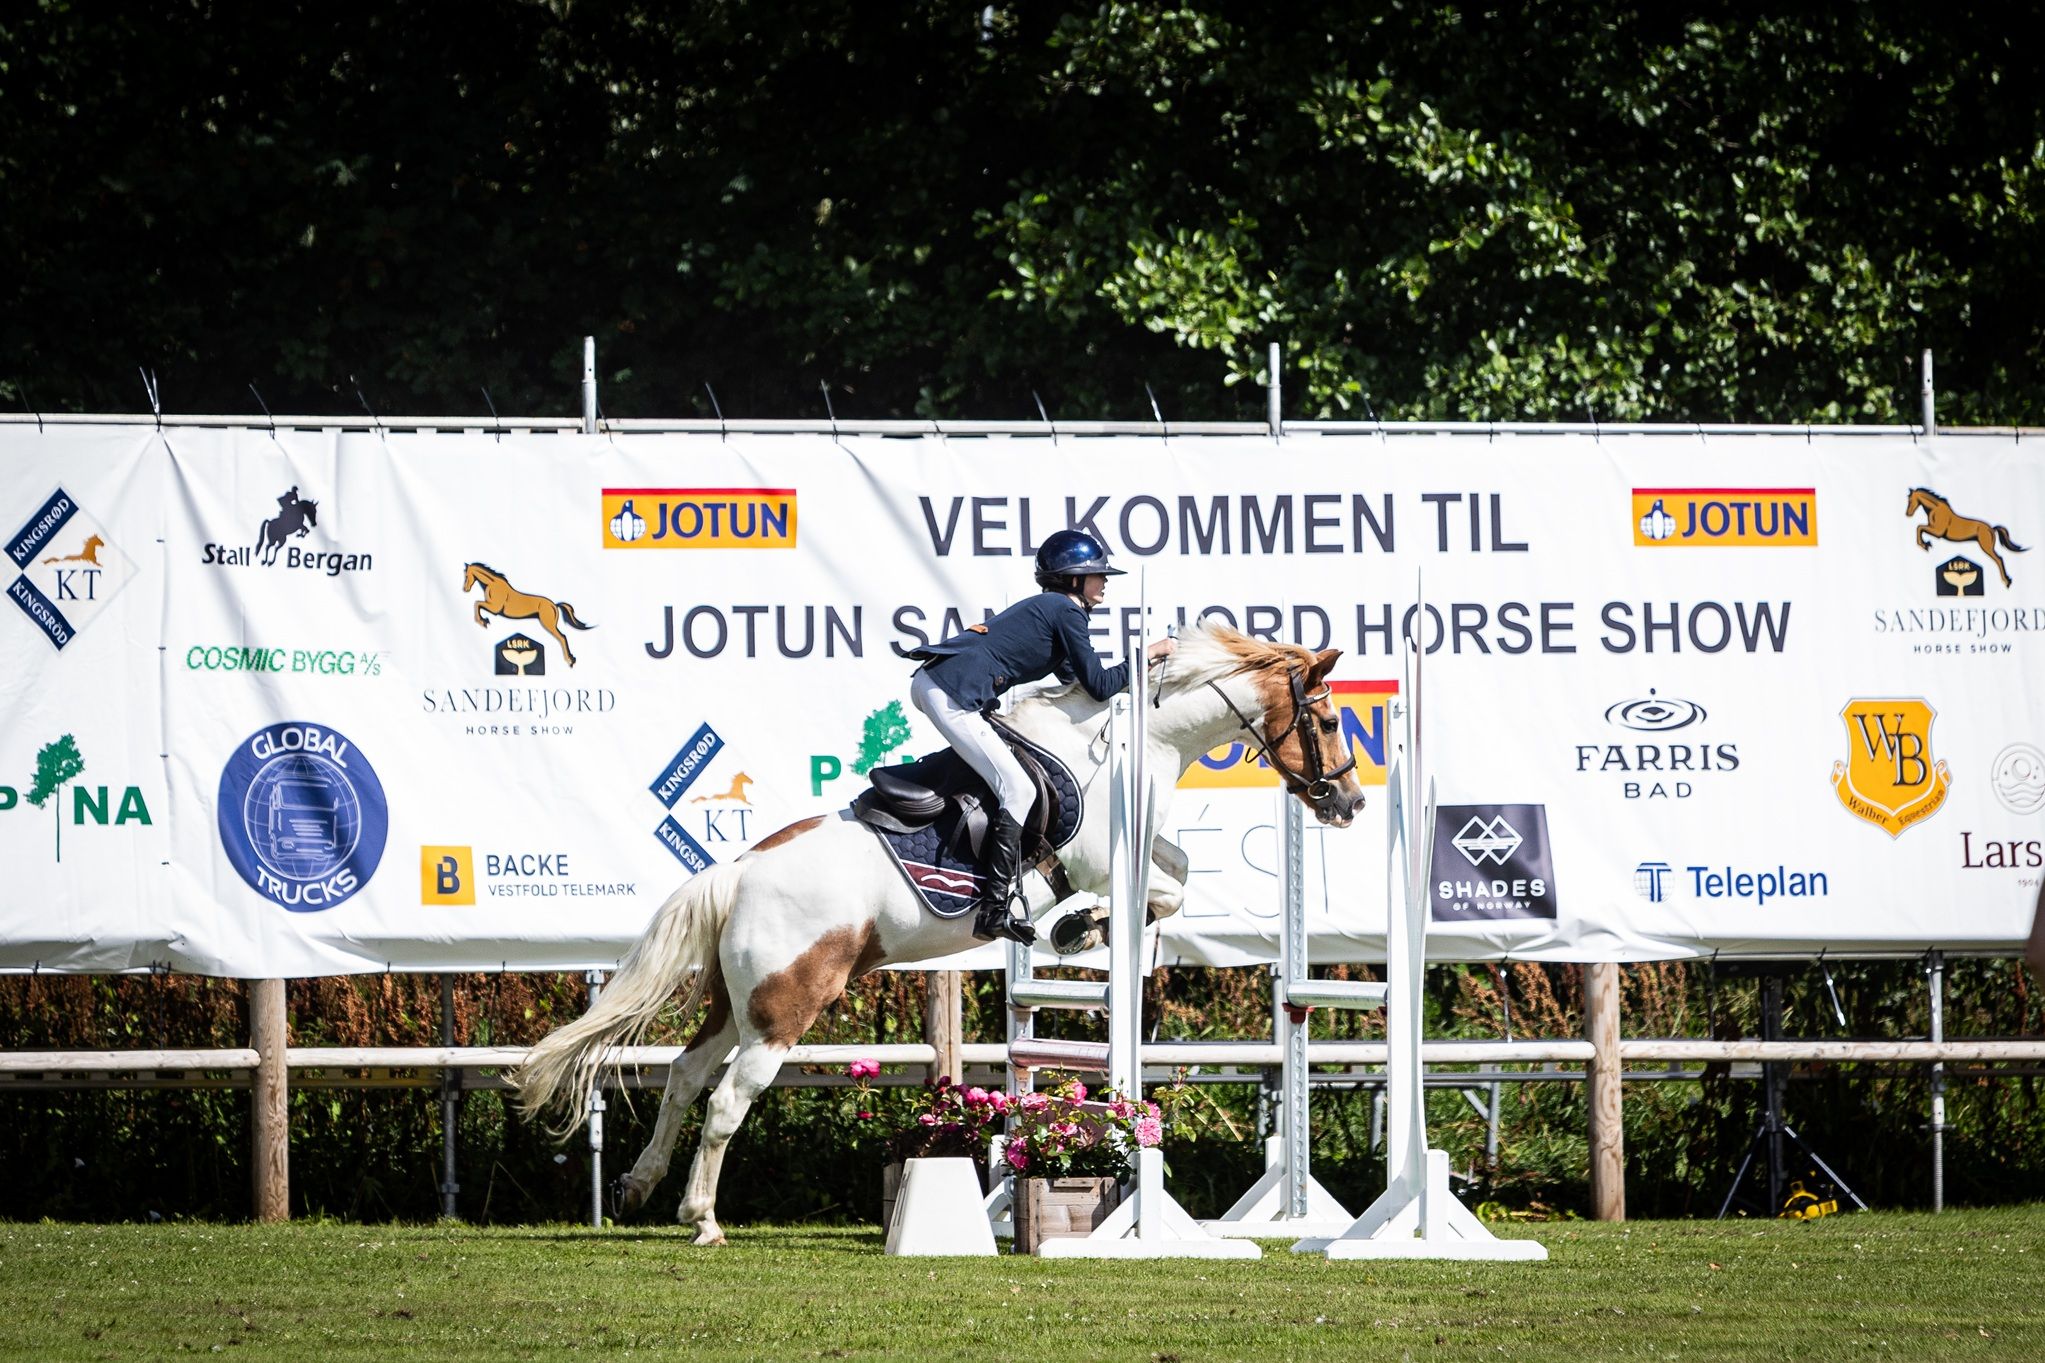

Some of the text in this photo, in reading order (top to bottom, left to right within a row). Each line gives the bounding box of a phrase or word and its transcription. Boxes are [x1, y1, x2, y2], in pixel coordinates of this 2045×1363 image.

[12, 497, 70, 562] KINGSRØD
[652, 502, 788, 540] JOTUN
[918, 493, 1529, 556] VELKOMMEN TIL
[1682, 502, 1809, 538] JOTUN
[202, 543, 372, 576] Stall Bergan
[56, 568, 102, 601] KT
[645, 604, 863, 659] JOTUN
[1356, 602, 1577, 654] HORSE
[1600, 601, 1791, 653] SHOW
[1874, 608, 2045, 638] SANDEFJORD
[187, 646, 286, 672] COSMIC
[292, 651, 356, 675] BYGG
[1914, 644, 2012, 654] HORSE SHOW
[423, 689, 615, 719] SANDEFJORD
[251, 727, 348, 768] GLOBAL
[466, 726, 573, 736] HORSE SHOW
[658, 731, 717, 802] KINGSRØD
[1575, 743, 1740, 772] FARRIS
[1624, 782, 1692, 799] BAD
[705, 808, 754, 842] KT
[658, 822, 706, 873] KINGSR
[1960, 831, 2043, 868] Lars
[436, 855, 461, 894] B
[486, 854, 569, 877] BACKE
[255, 864, 359, 906] TRUCKS
[488, 882, 637, 897] VESTFOLD TELEMARK
[1438, 878, 1546, 900] SHADES
[1687, 866, 1828, 906] Teleplan
[1452, 901, 1532, 912] OF NORWAY
